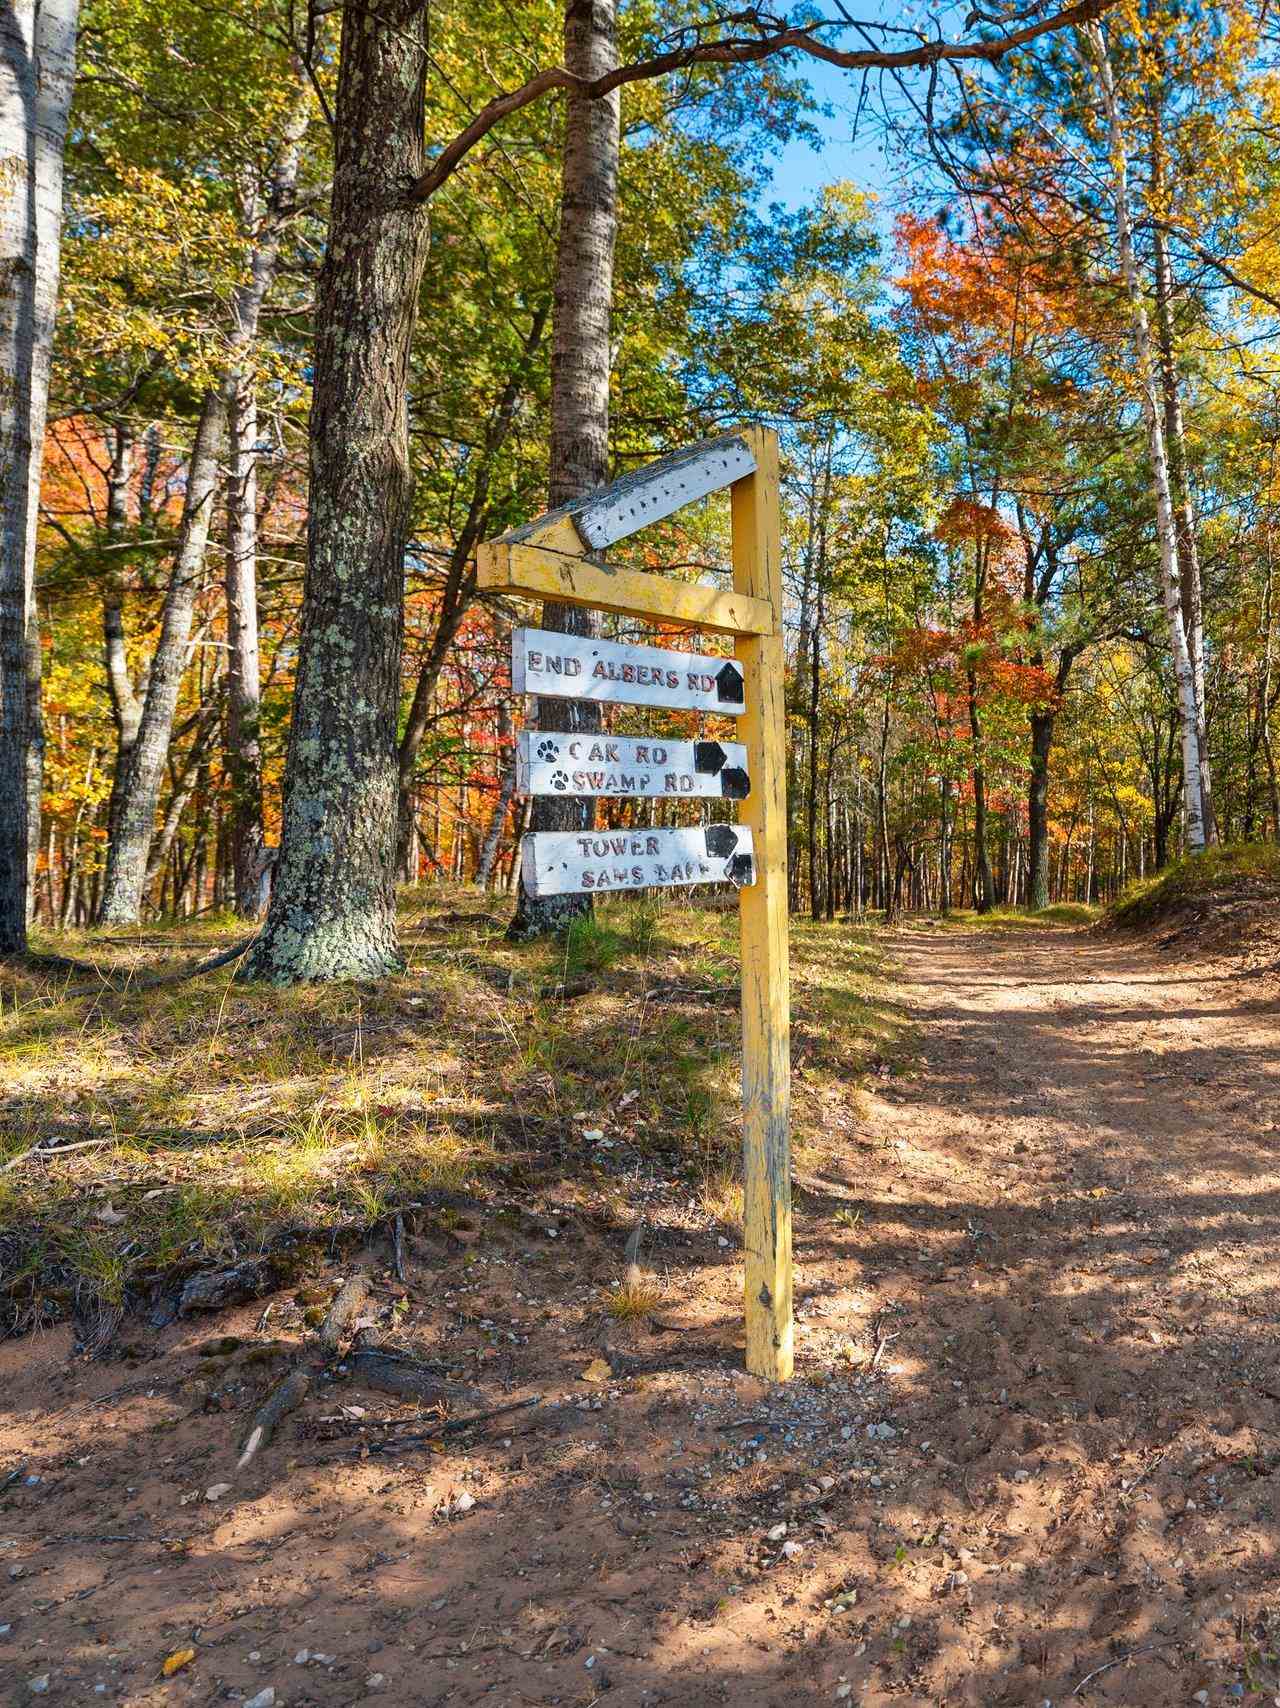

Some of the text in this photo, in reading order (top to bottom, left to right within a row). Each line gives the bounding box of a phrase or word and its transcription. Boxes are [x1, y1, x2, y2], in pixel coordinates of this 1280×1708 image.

[528, 650, 715, 692] END ALBERS RD
[636, 746, 667, 764] RD
[572, 769, 650, 791] SWAMP
[578, 837, 660, 858] TOWER
